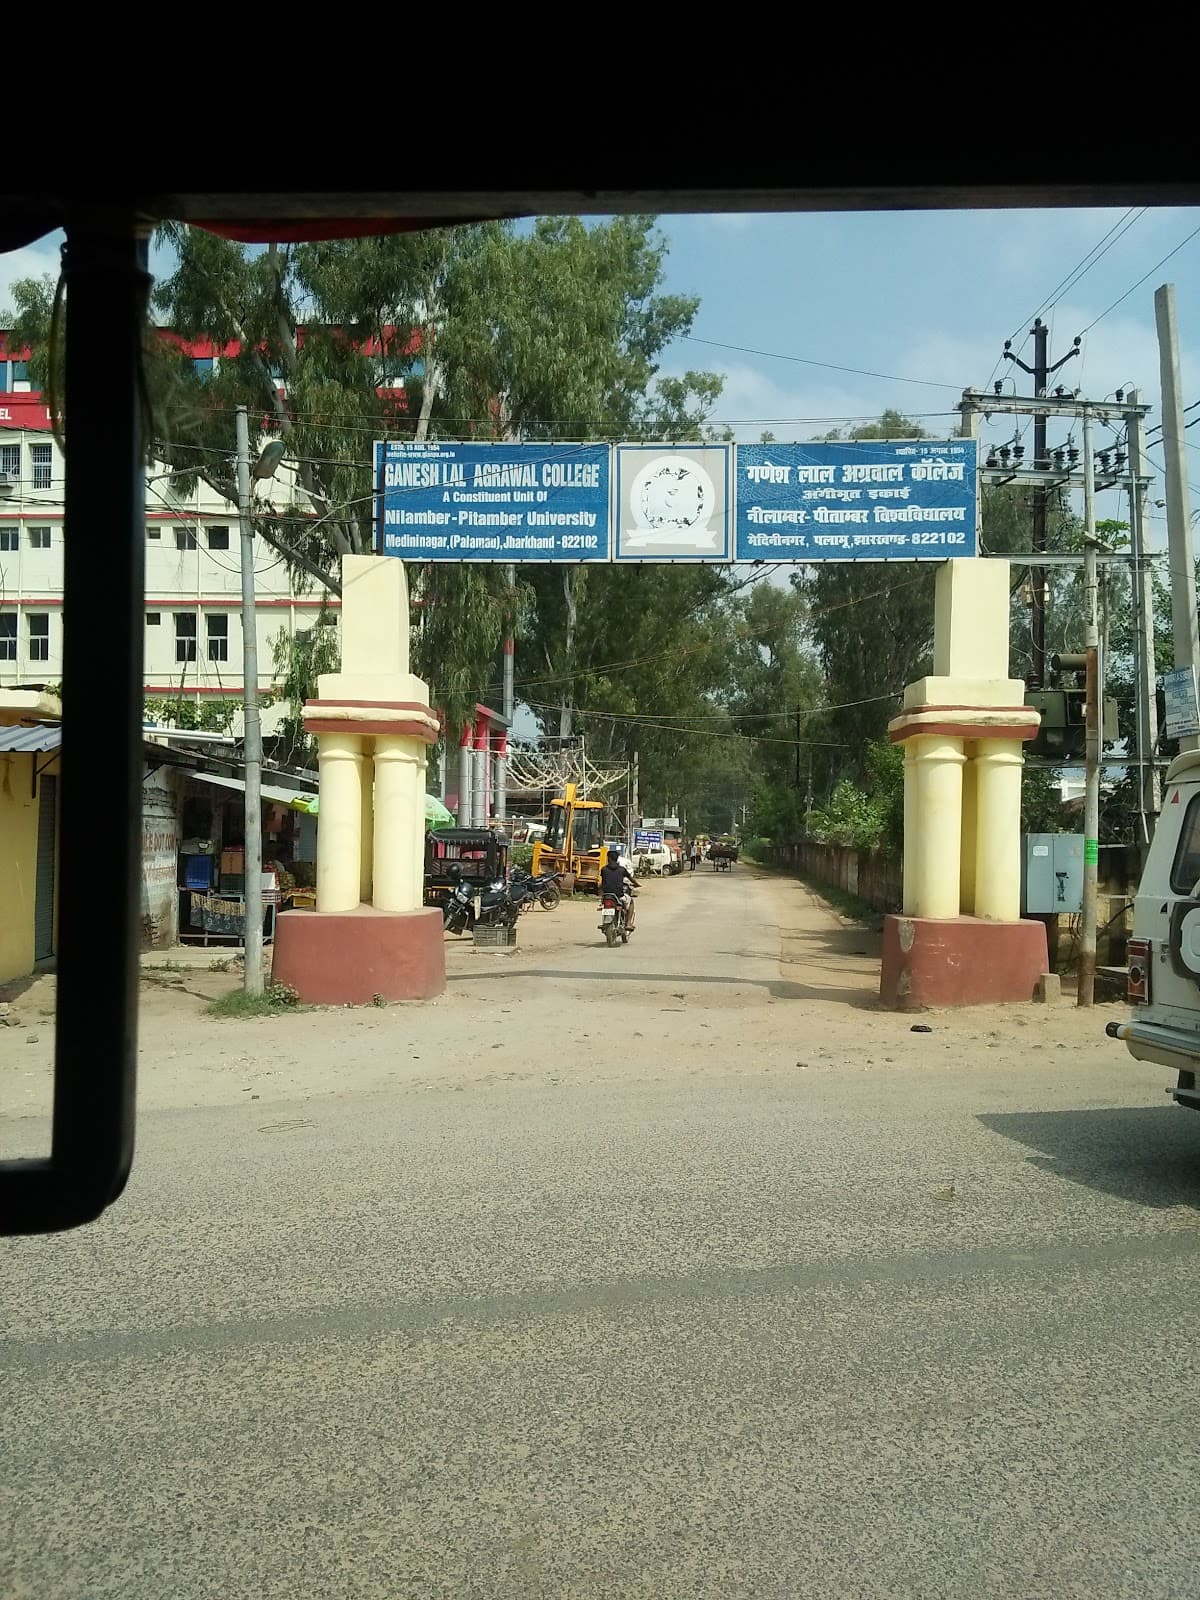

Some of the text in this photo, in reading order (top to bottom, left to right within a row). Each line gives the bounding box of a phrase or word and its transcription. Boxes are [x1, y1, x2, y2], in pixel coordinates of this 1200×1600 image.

[384, 463, 600, 488] GANESH LAL AGRAWAL COLLEGE
[747, 458, 966, 484] गणेश लाल अग्रवाल कॉलेज
[442, 491, 548, 503] A Constituent Unit Of
[866, 486, 913, 500] इकाई
[527, 510, 597, 528] University
[873, 505, 967, 523] विश्वविद्यालय
